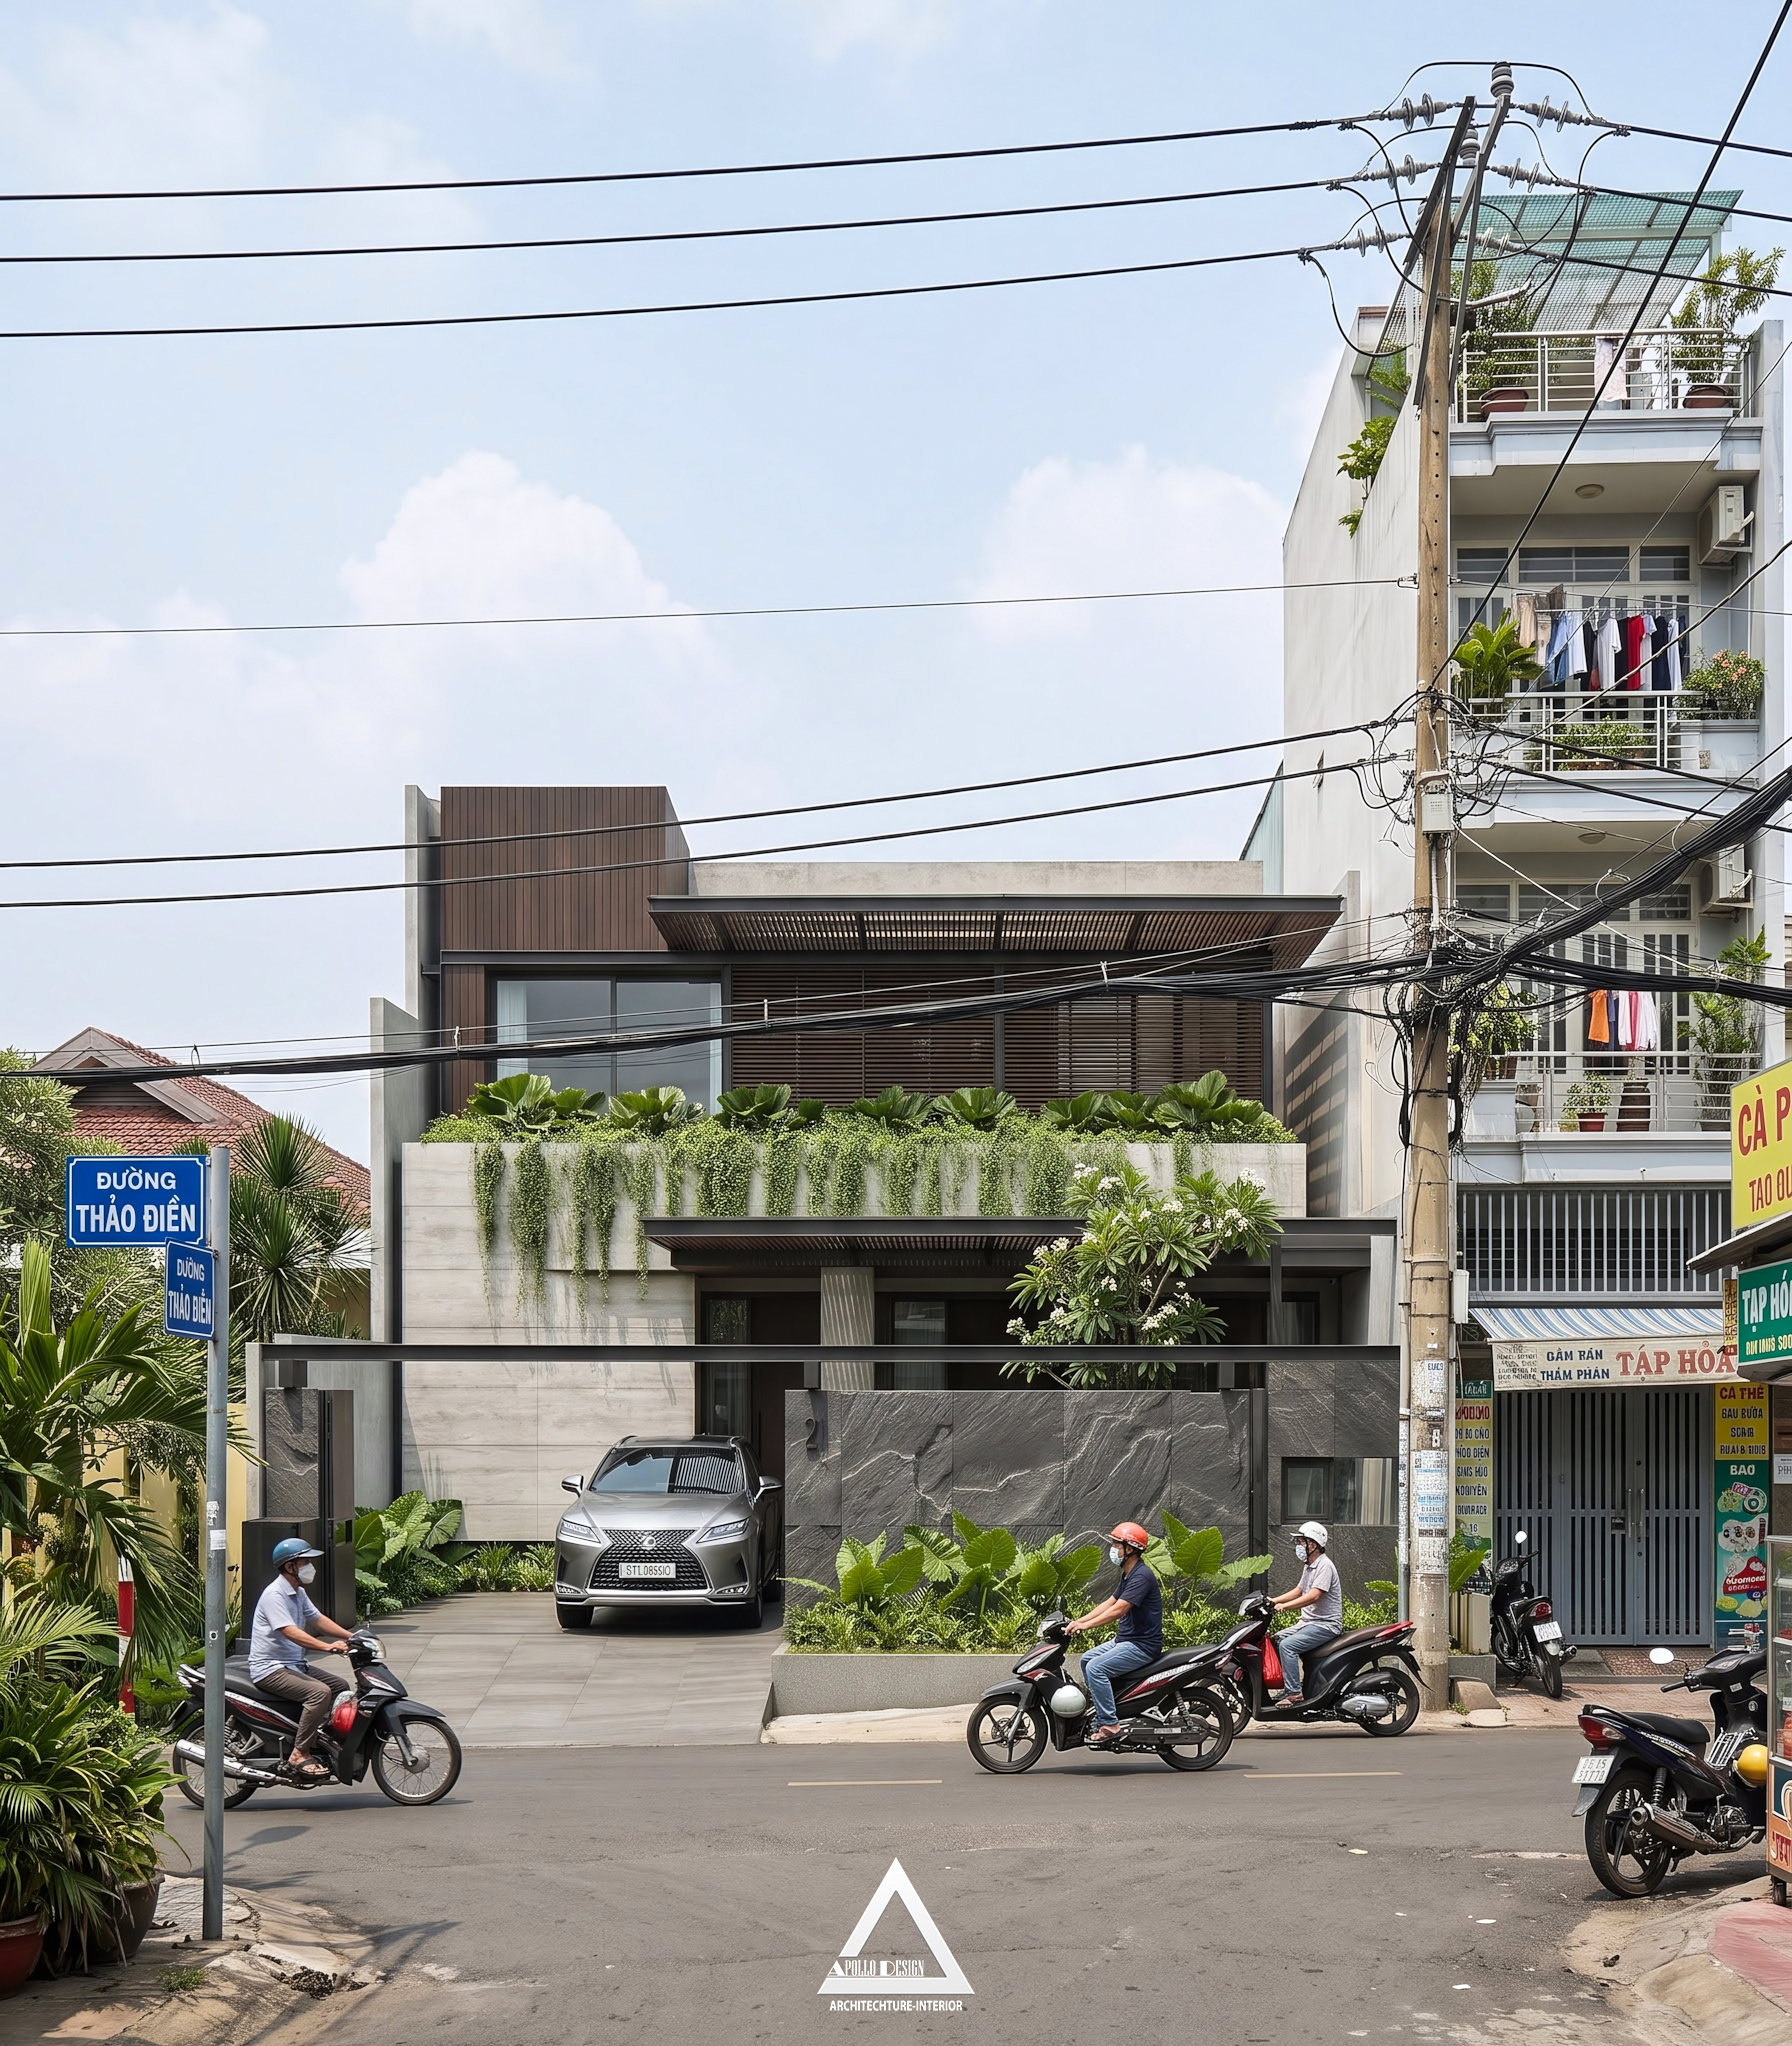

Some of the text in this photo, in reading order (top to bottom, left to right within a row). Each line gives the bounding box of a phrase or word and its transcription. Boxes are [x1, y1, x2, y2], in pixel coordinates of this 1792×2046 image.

[1738, 1084, 1768, 1157] CÀ
[96, 1166, 176, 1190] ĐƯỜNG
[1748, 1173, 1773, 1213] TAO
[76, 1194, 196, 1233] THẢO ĐIỀN
[1742, 1286, 1768, 1333] TẠP
[1770, 1269, 1792, 1321] HÓ
